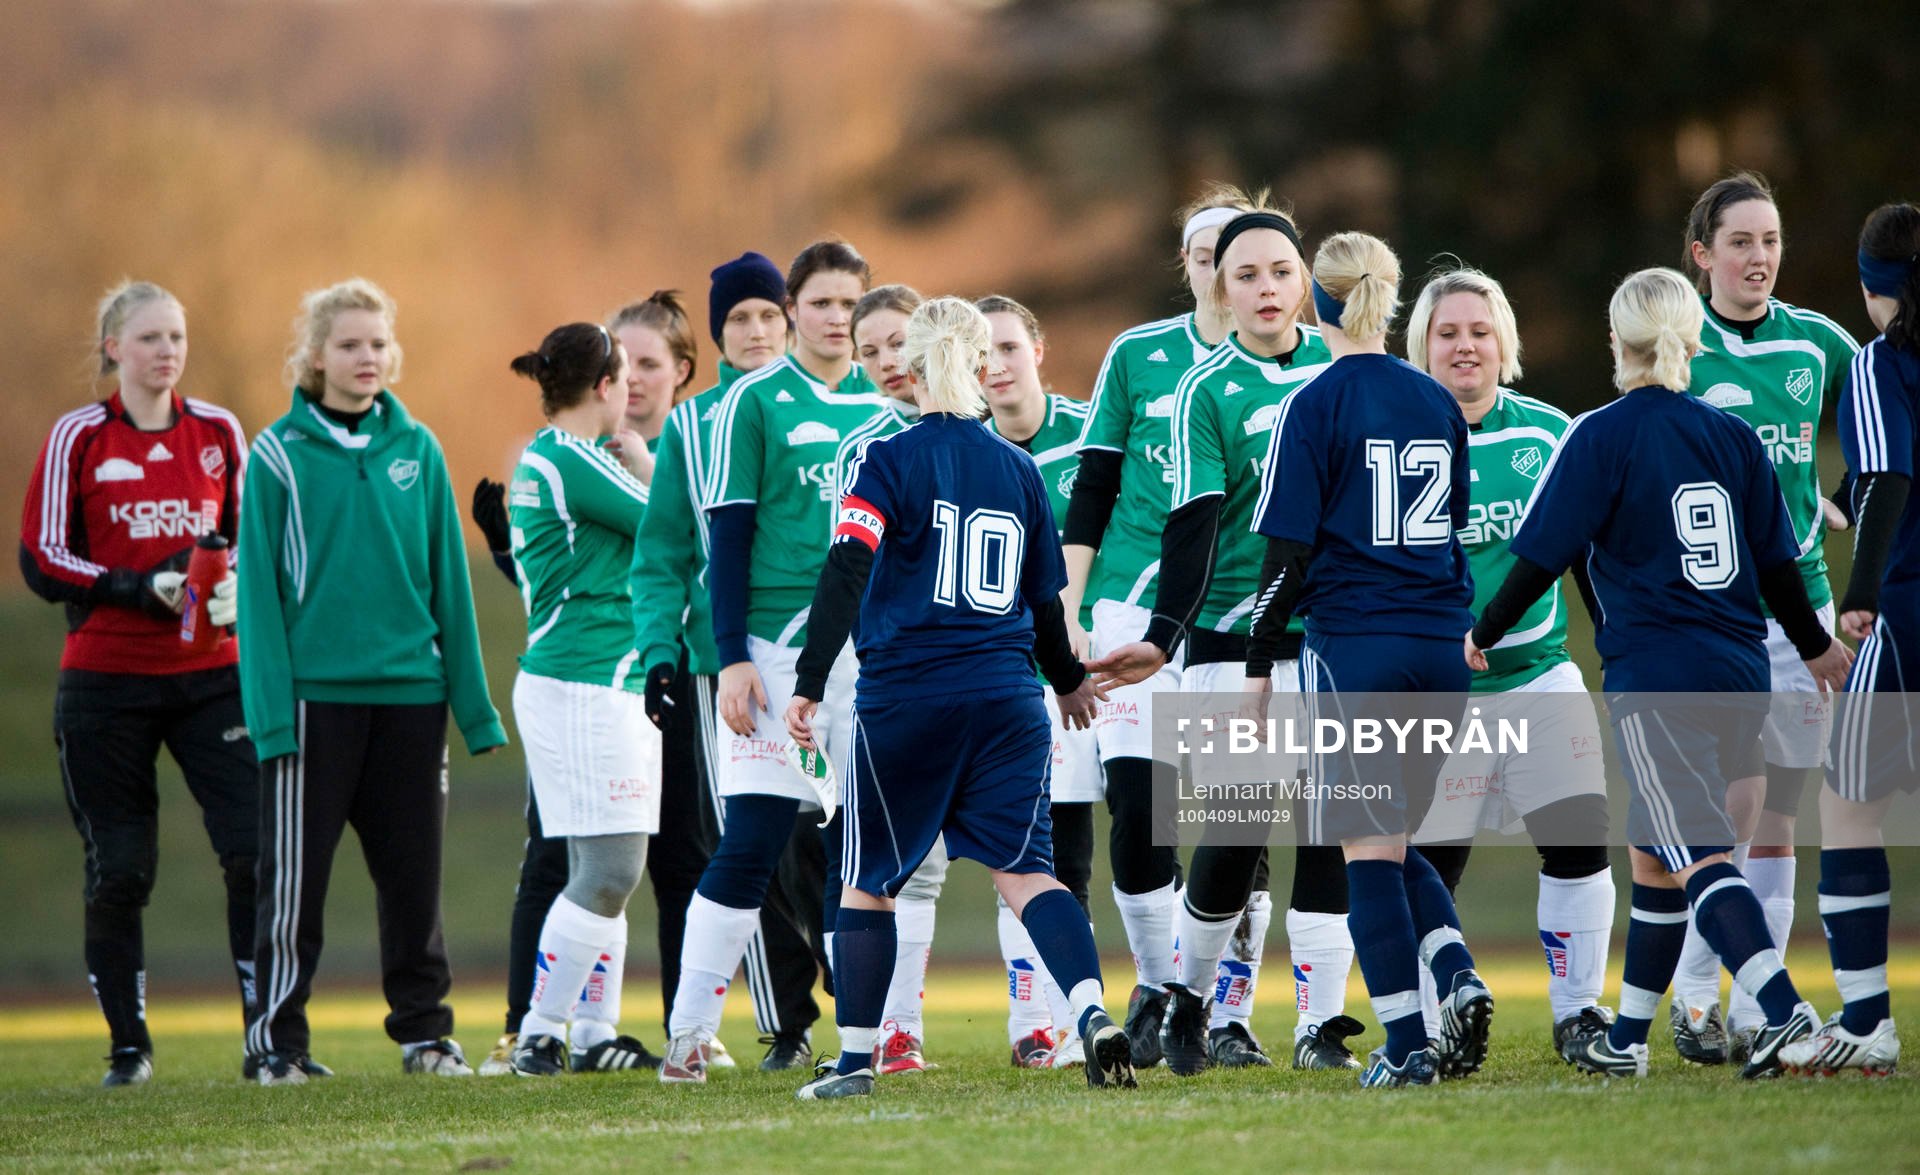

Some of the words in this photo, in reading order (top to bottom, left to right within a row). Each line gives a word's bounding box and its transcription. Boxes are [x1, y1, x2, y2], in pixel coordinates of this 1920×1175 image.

[1790, 373, 1811, 394] VKIF
[1516, 450, 1538, 471] VKIF
[1365, 439, 1452, 546] 12
[1671, 481, 1739, 590] 9
[932, 499, 1025, 615] 10
[1552, 950, 1567, 977] INTER
[589, 973, 604, 1002] INTER
[1018, 971, 1032, 1001] INTER
[1226, 977, 1248, 1007] INTER
[1300, 983, 1309, 1010] INTER
